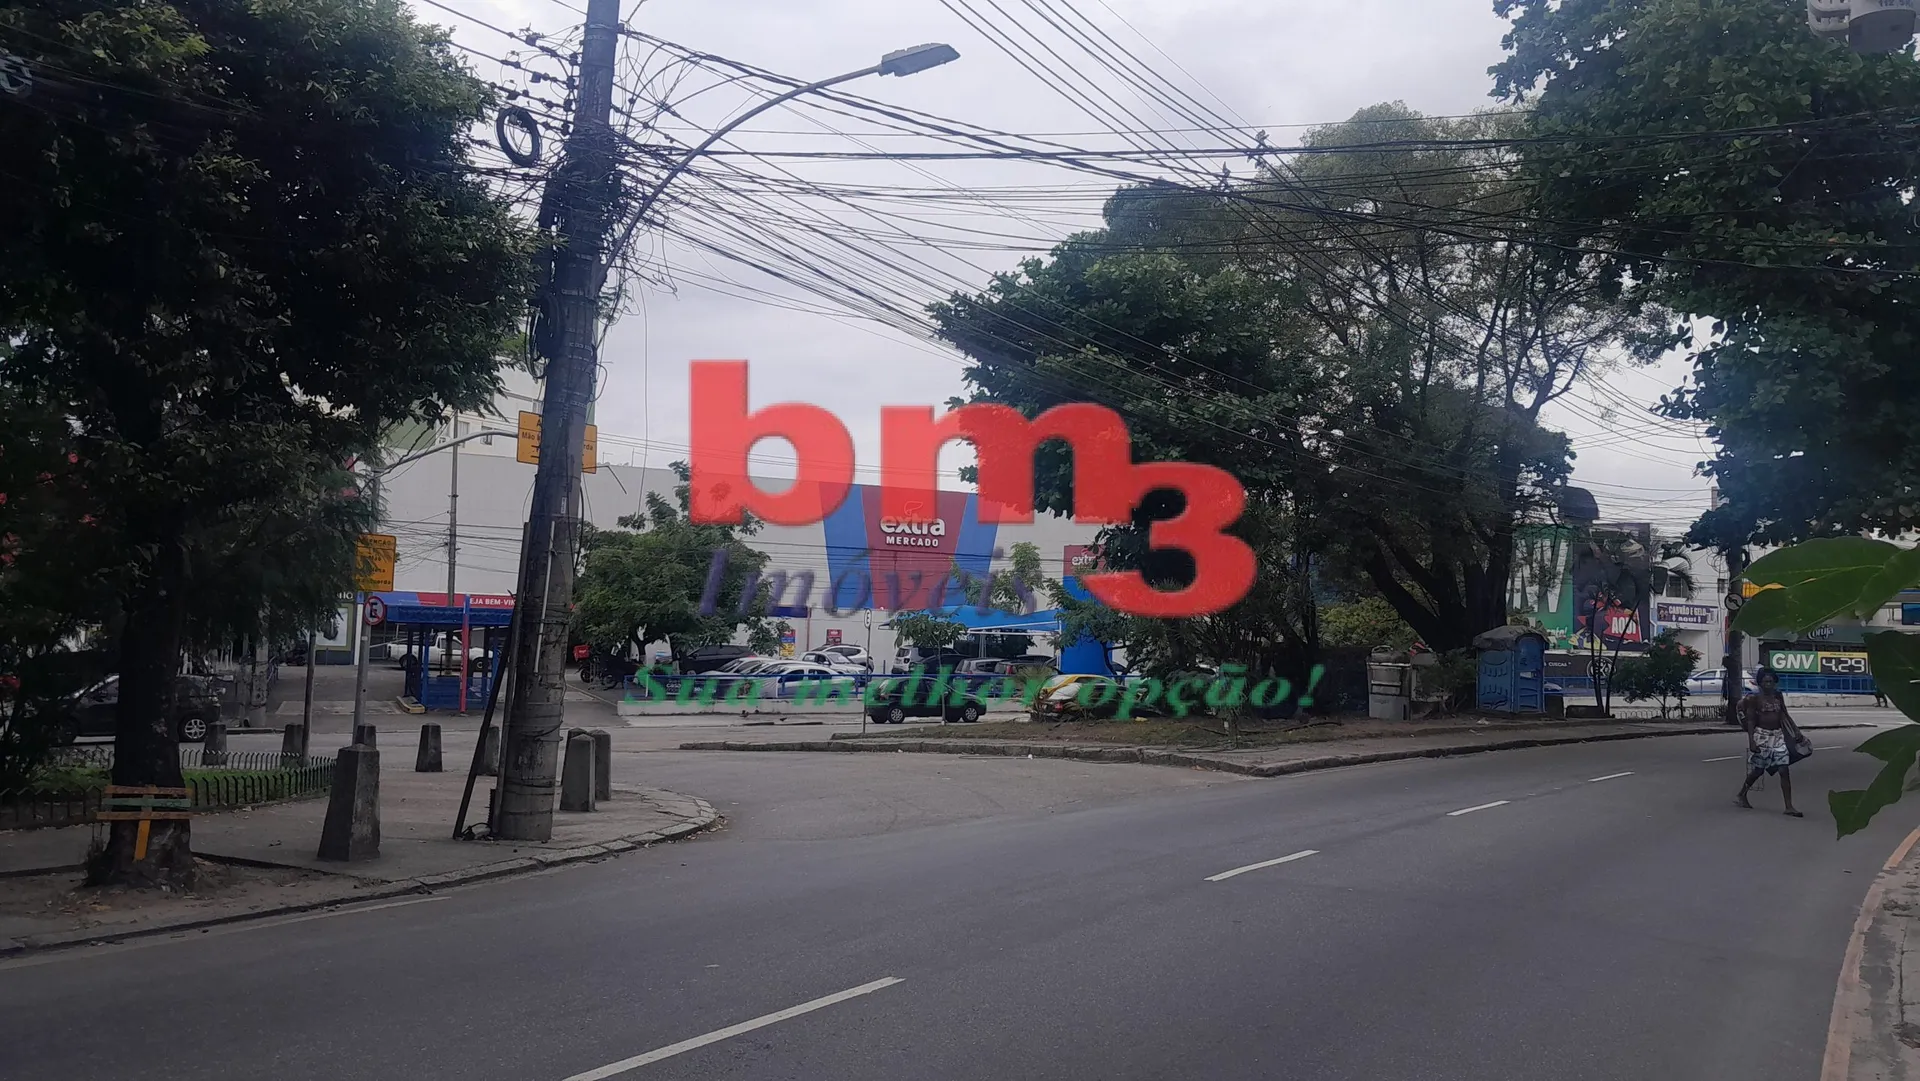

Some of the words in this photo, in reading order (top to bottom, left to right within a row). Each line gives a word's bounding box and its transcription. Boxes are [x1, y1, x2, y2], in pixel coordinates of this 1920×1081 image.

[880, 513, 945, 536] extra
[886, 536, 939, 547] MERCADO
[1071, 554, 1097, 566] extr
[369, 602, 378, 618] E
[1772, 653, 1815, 670] GNV
[1822, 657, 1865, 673] 4,29
